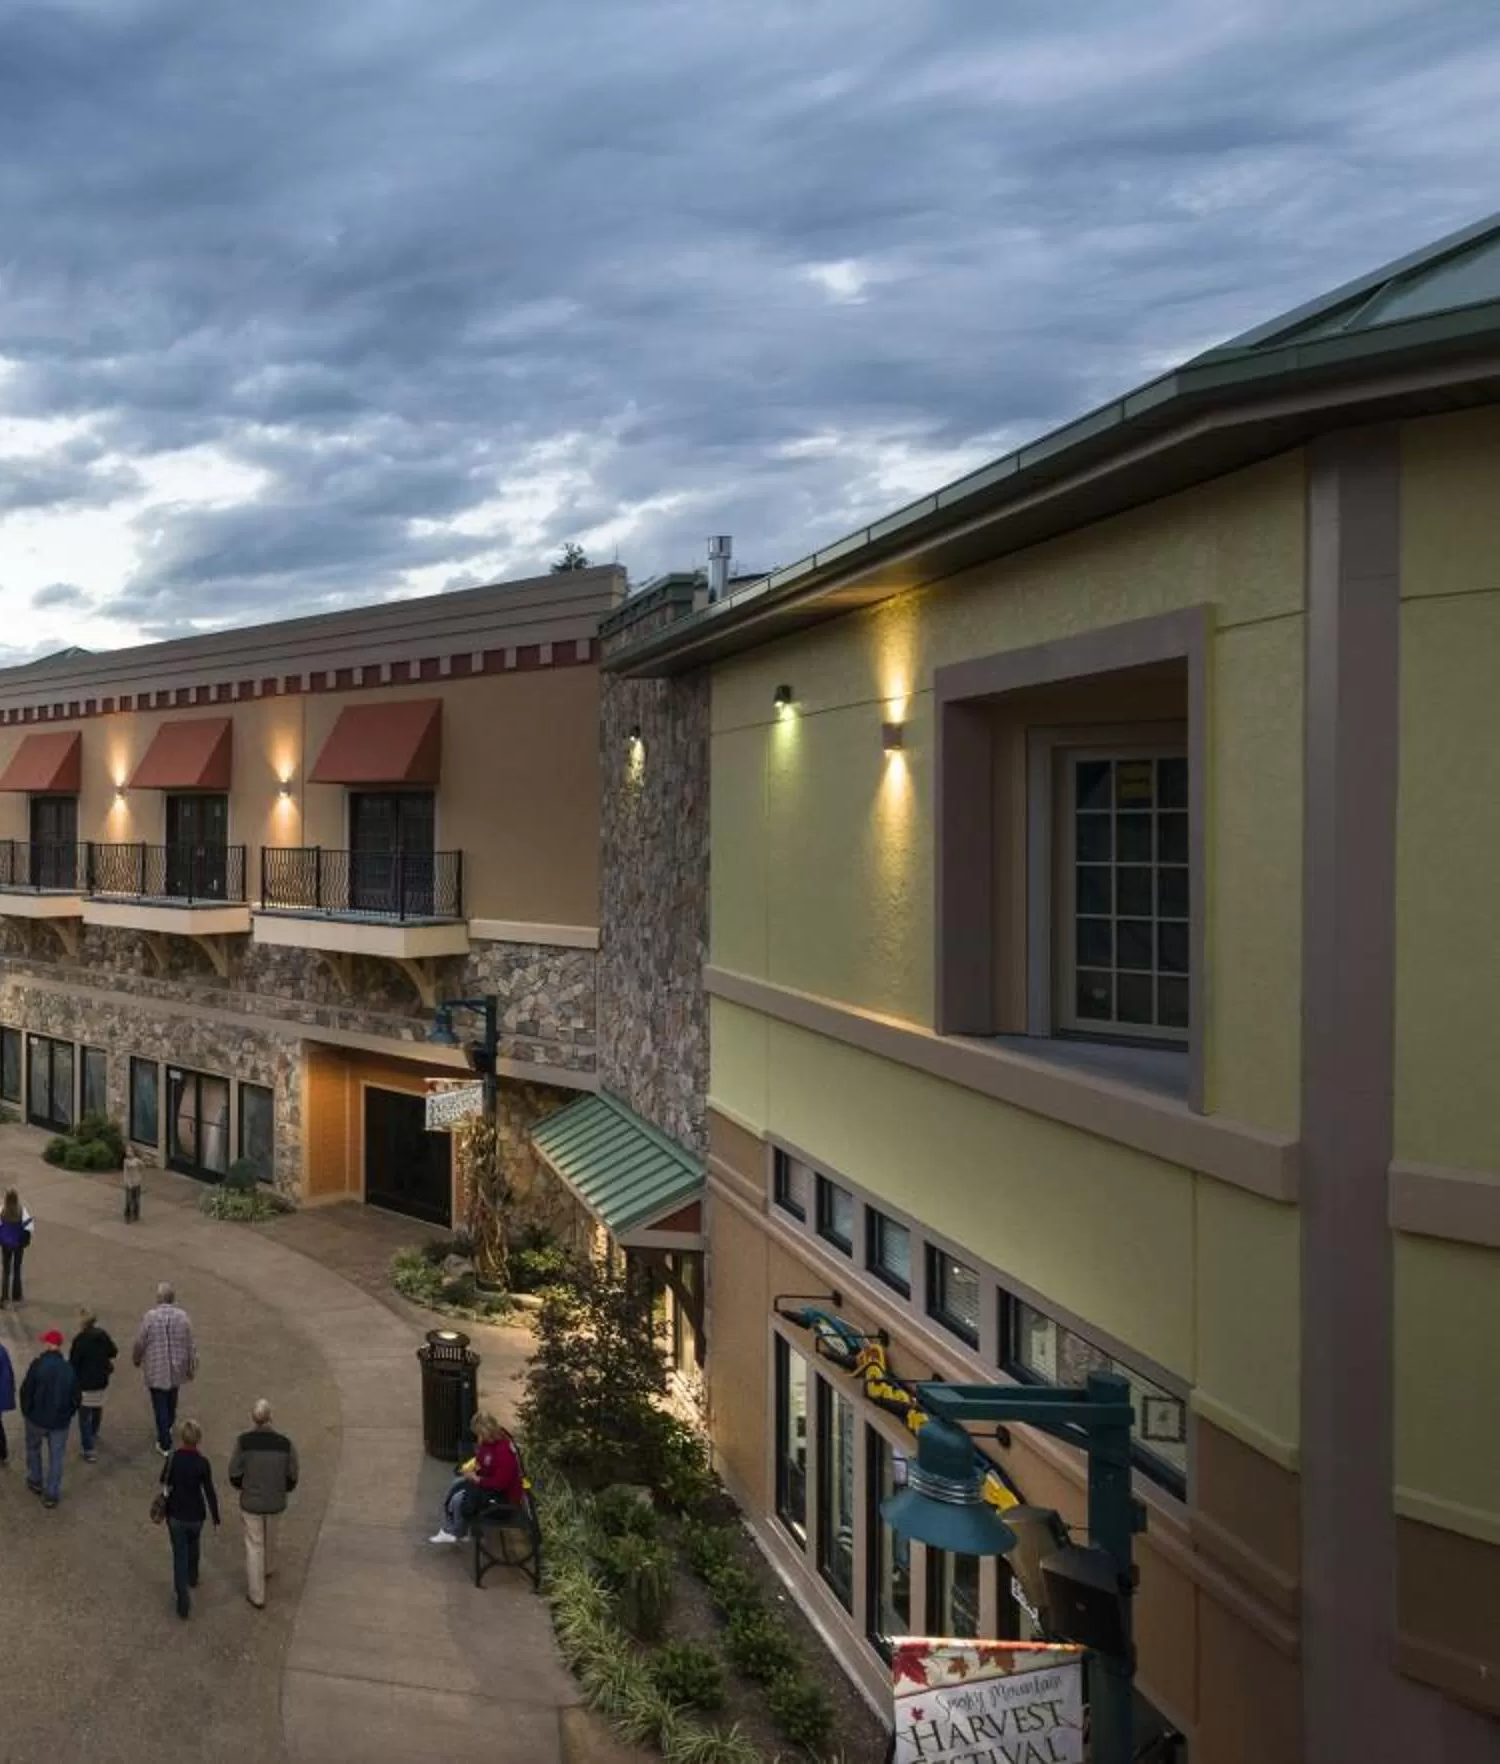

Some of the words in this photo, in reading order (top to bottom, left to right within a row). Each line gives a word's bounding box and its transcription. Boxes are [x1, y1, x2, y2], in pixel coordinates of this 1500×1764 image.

[989, 1674, 1062, 1708] Mountain
[909, 1699, 1064, 1757] HARVEST
[909, 1736, 1068, 1764] TIVAL
